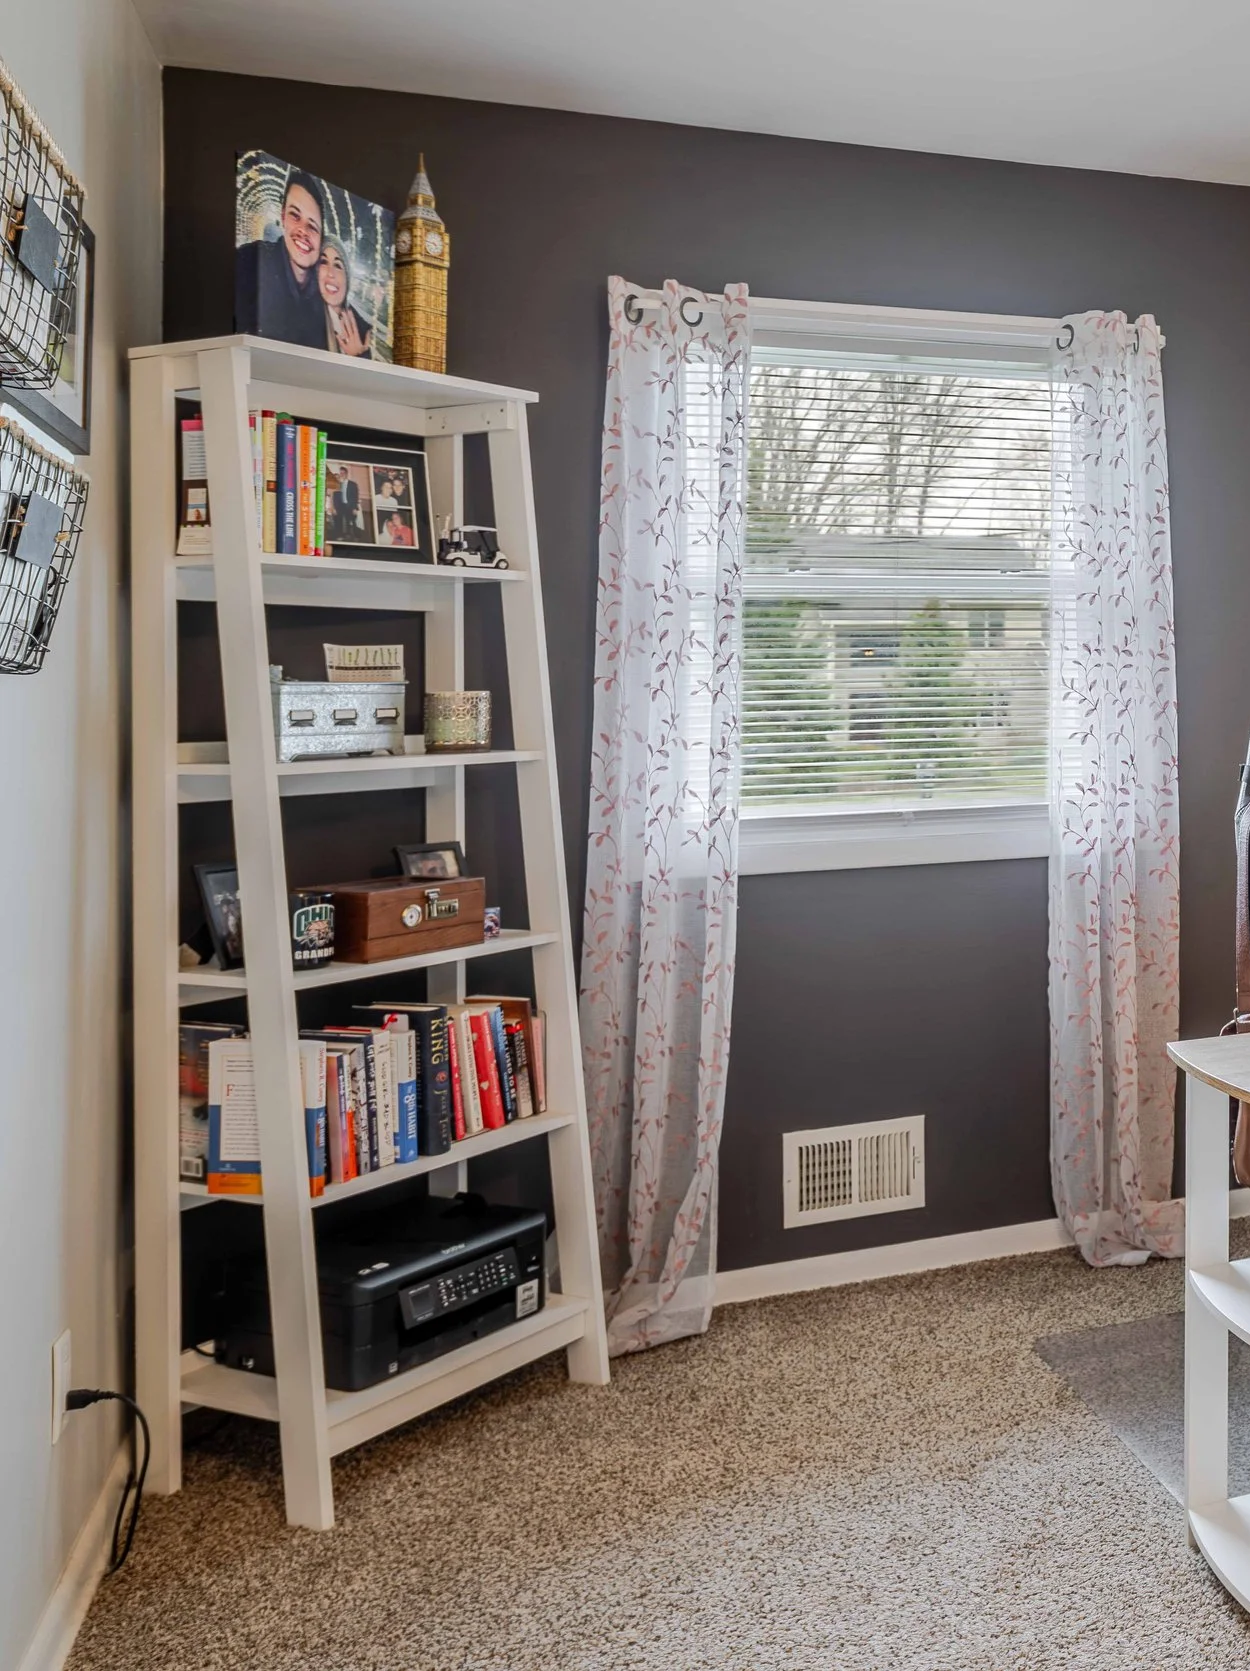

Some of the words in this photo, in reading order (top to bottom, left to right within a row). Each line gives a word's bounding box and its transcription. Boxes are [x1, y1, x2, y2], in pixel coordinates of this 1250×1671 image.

[286, 492, 294, 511] CROSS
[286, 524, 294, 537] LINE
[430, 1019, 443, 1064] KING
[505, 1053, 513, 1074] USED
[508, 1076, 514, 1086] TO
[404, 1095, 416, 1110] 8th
[510, 1089, 516, 1099] BE
[408, 1112, 416, 1139] HABIT
